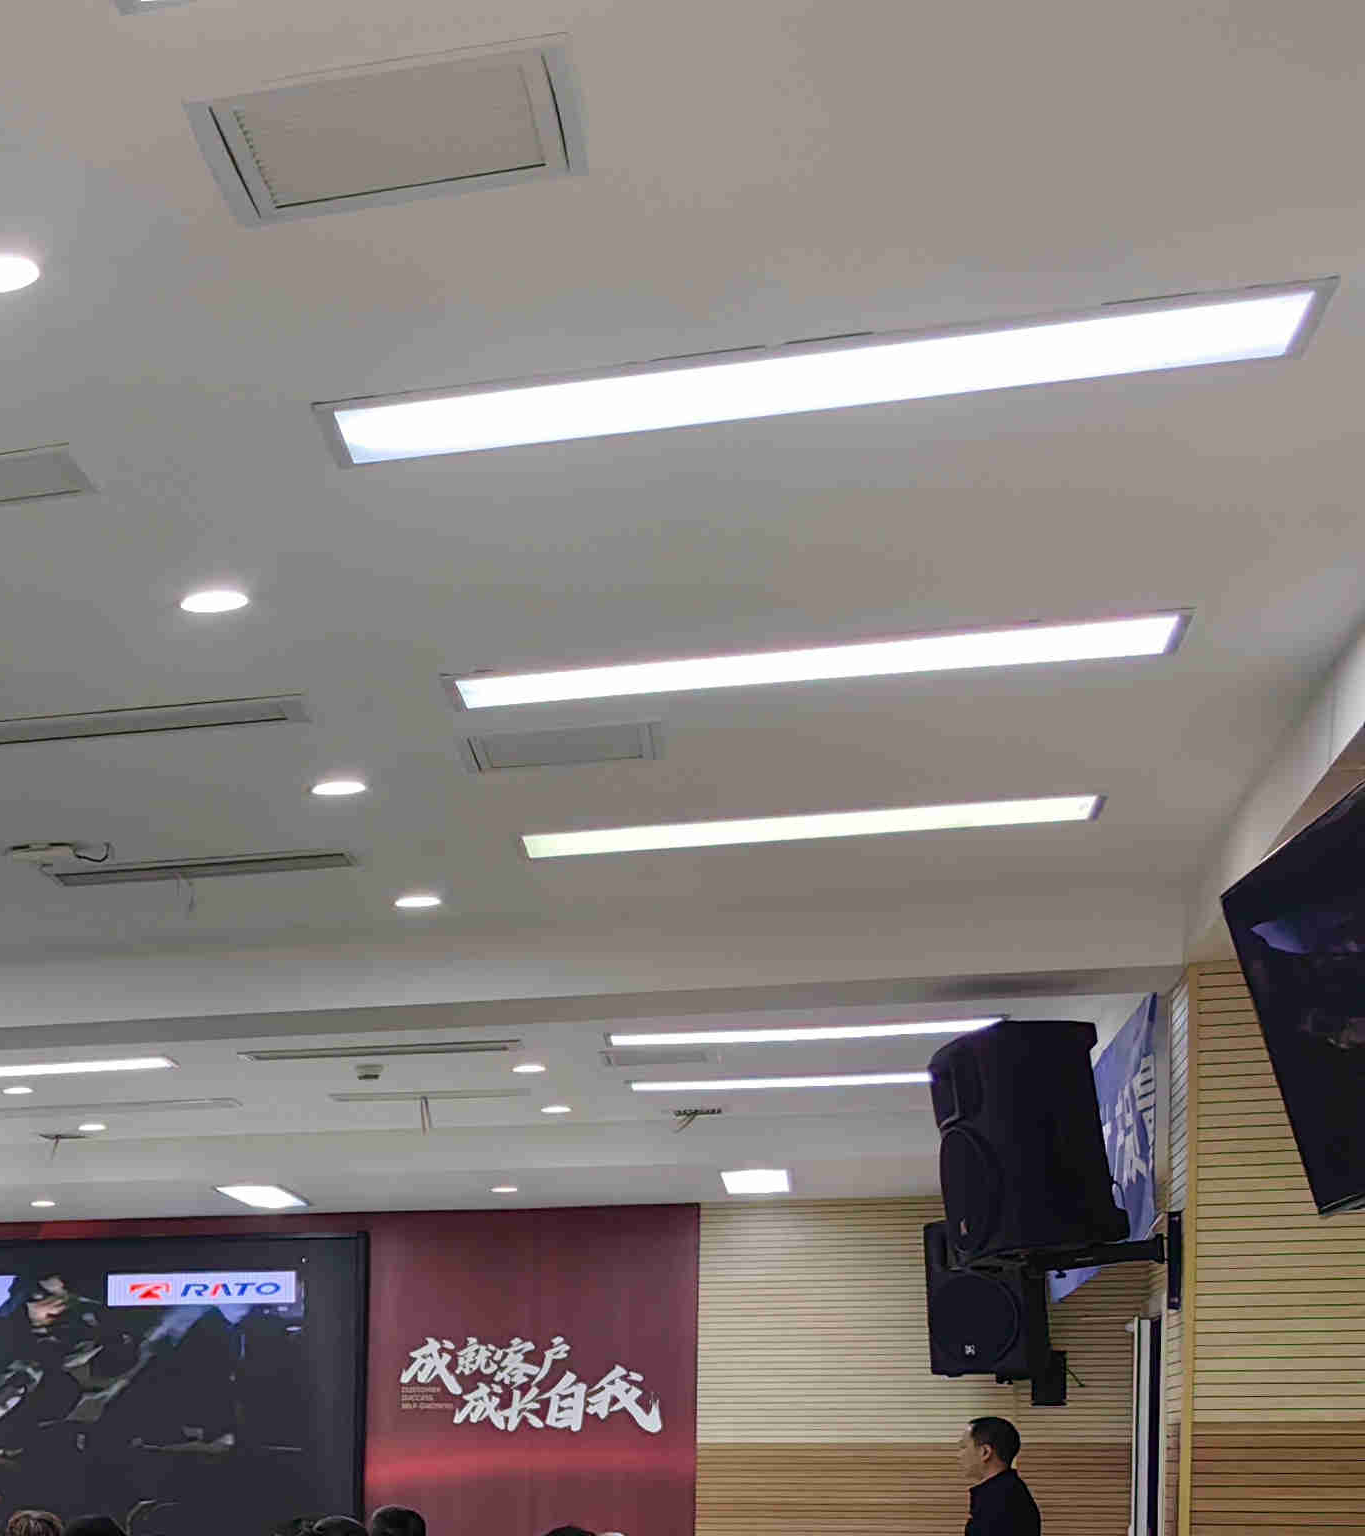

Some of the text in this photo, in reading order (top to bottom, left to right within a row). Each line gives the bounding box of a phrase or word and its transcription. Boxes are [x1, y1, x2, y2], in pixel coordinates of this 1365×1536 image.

[180, 1282, 281, 1297] RATO
[400, 1336, 569, 1395] 成就客户
[452, 1364, 662, 1433] 成长自我
